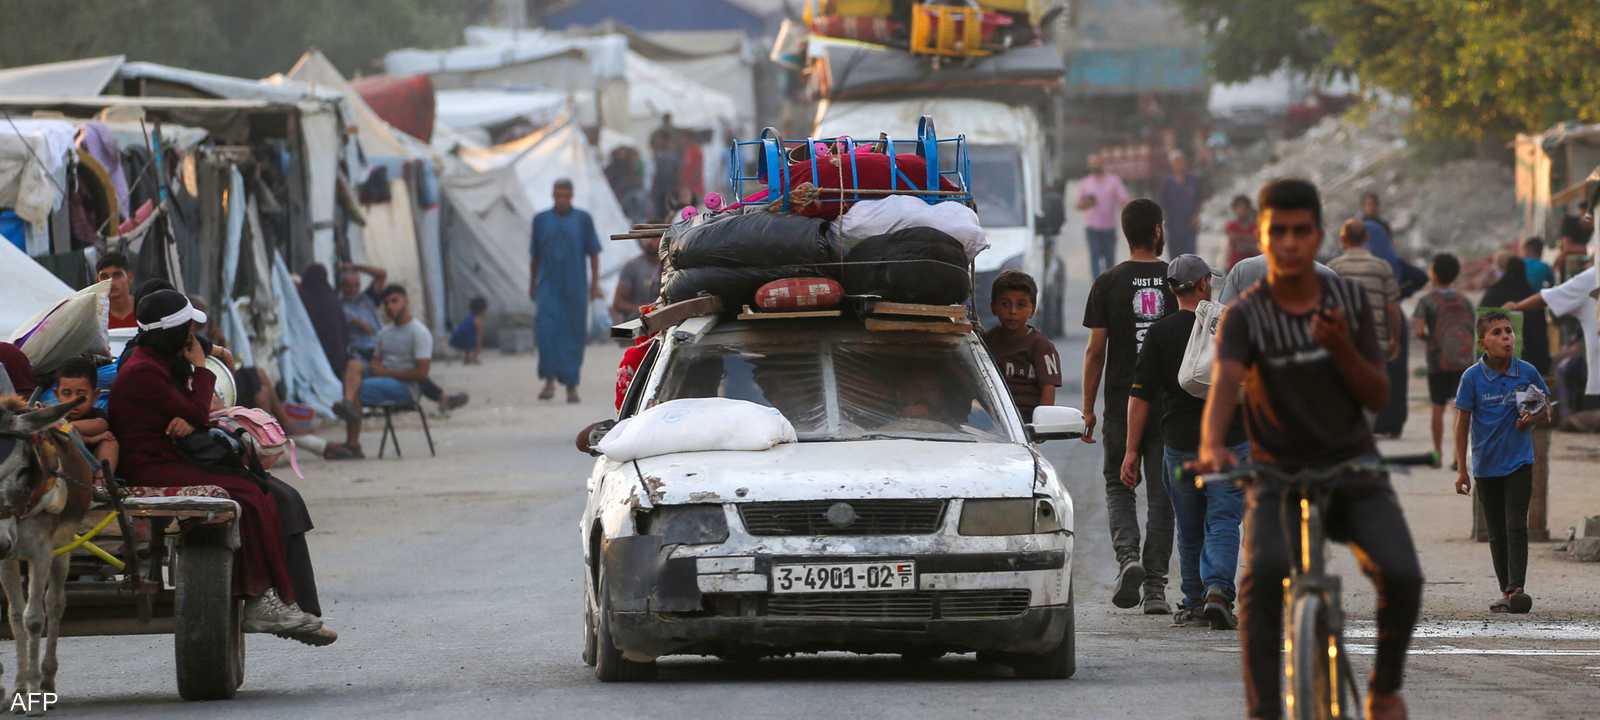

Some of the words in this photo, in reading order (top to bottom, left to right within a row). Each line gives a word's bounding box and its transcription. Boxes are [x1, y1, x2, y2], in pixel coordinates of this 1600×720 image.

[1132, 277, 1151, 287] JUST
[1153, 277, 1164, 286] BE
[1141, 291, 1157, 315] N
[779, 565, 893, 590] 3-4901-02
[901, 576, 910, 588] P
